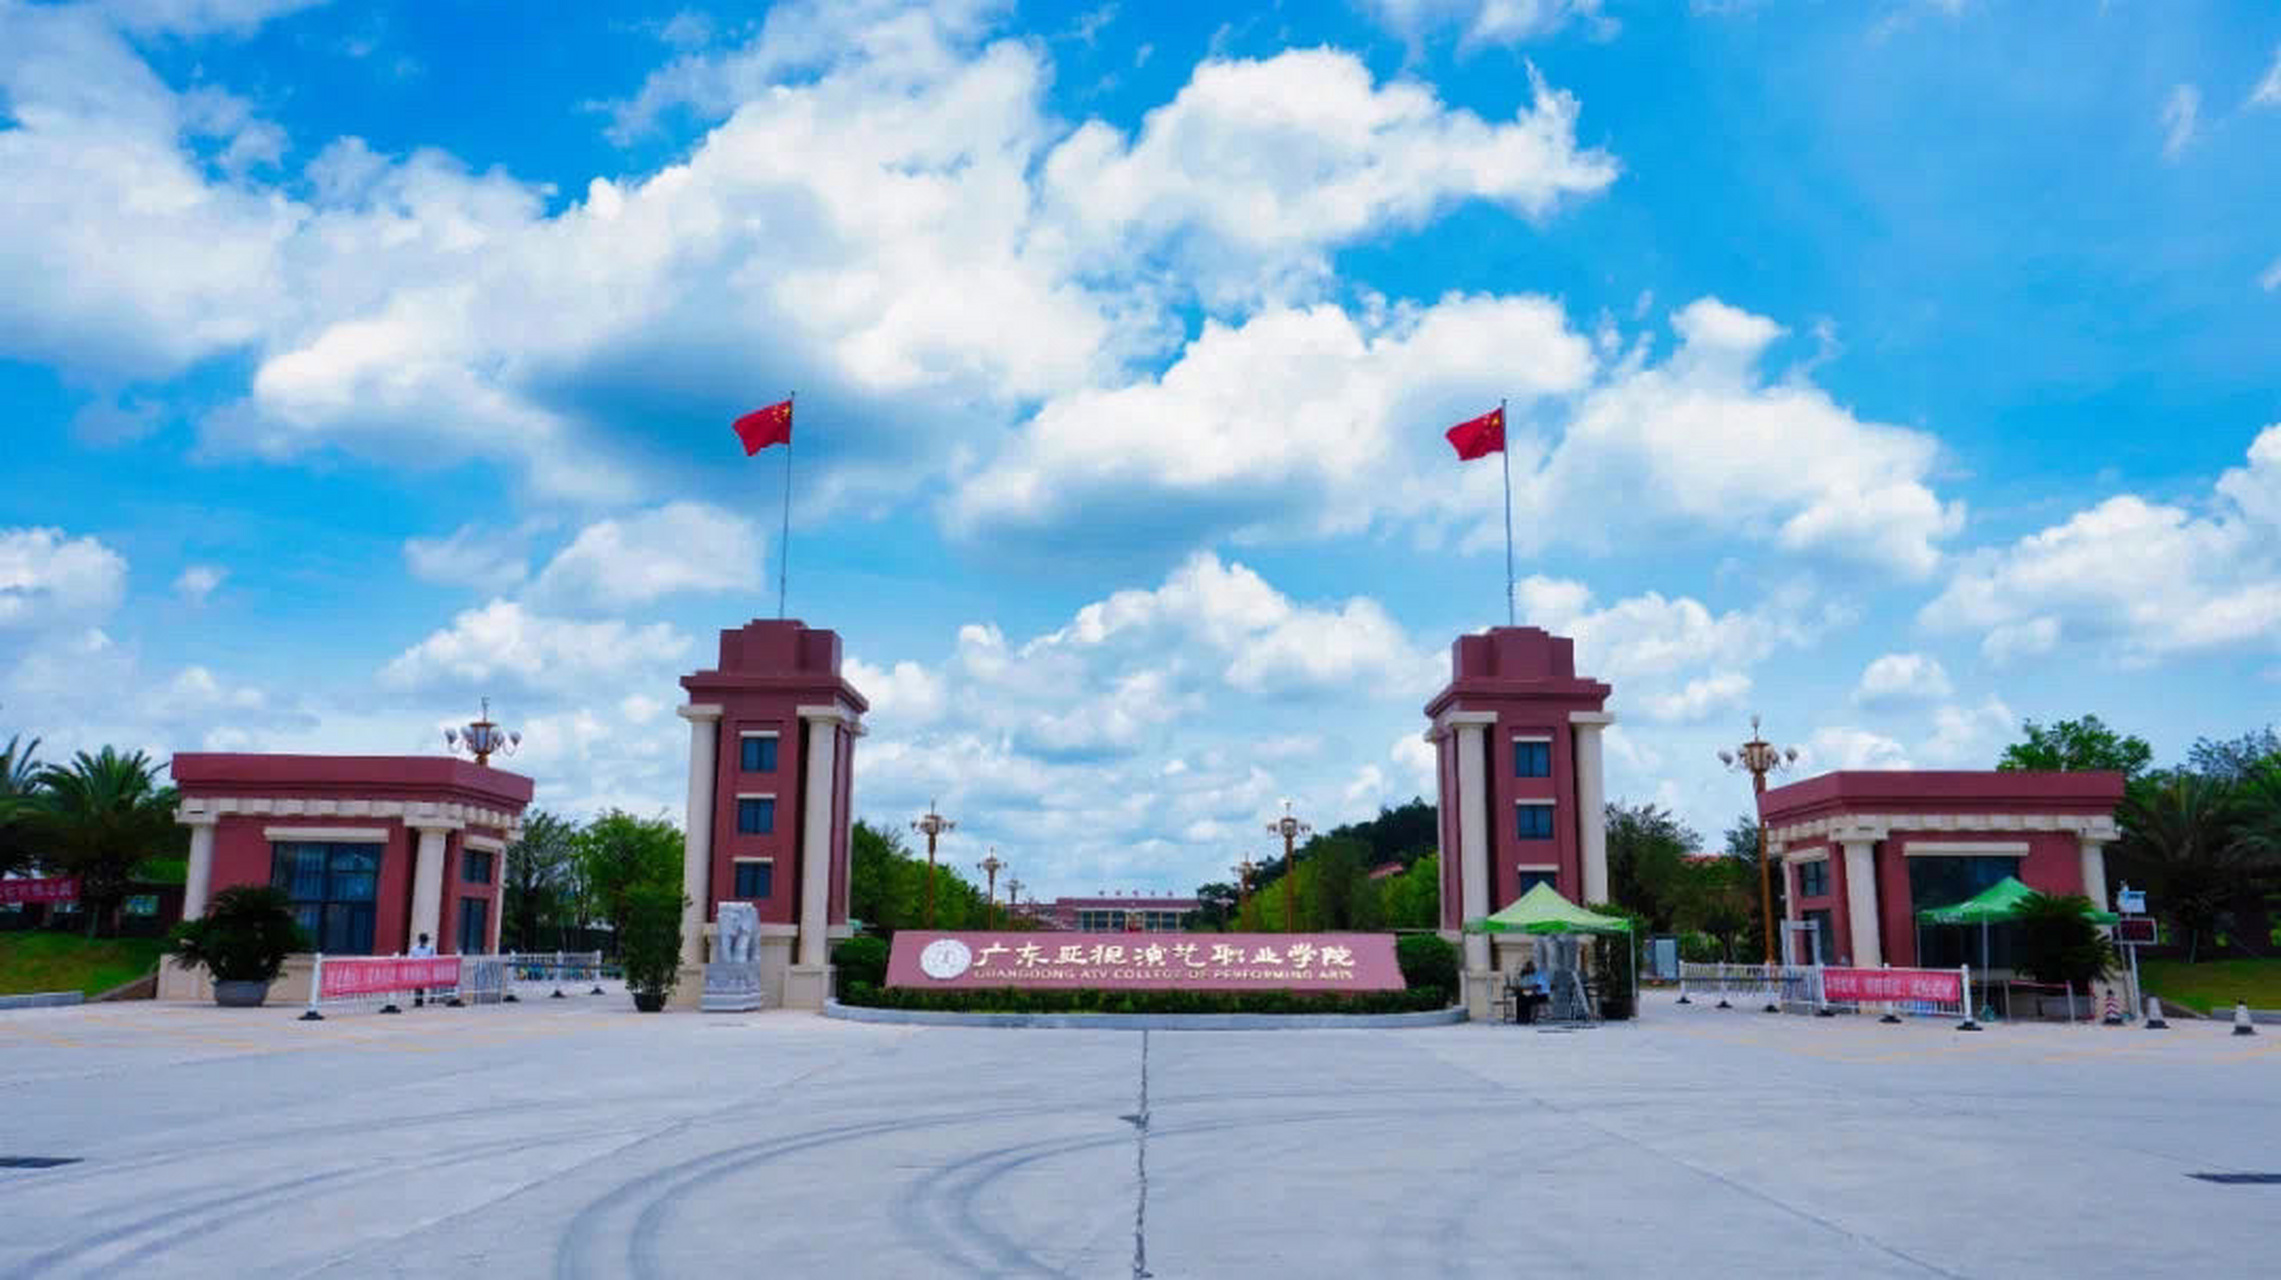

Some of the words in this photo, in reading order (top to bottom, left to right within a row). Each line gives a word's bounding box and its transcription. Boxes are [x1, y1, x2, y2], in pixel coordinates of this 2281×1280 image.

[974, 969, 1075, 979] GUANGDONG
[1081, 969, 1108, 979] ATV
[1113, 969, 1182, 979] COLLEGE
[1188, 969, 1207, 979] OF
[1319, 969, 1353, 979] ARTS
